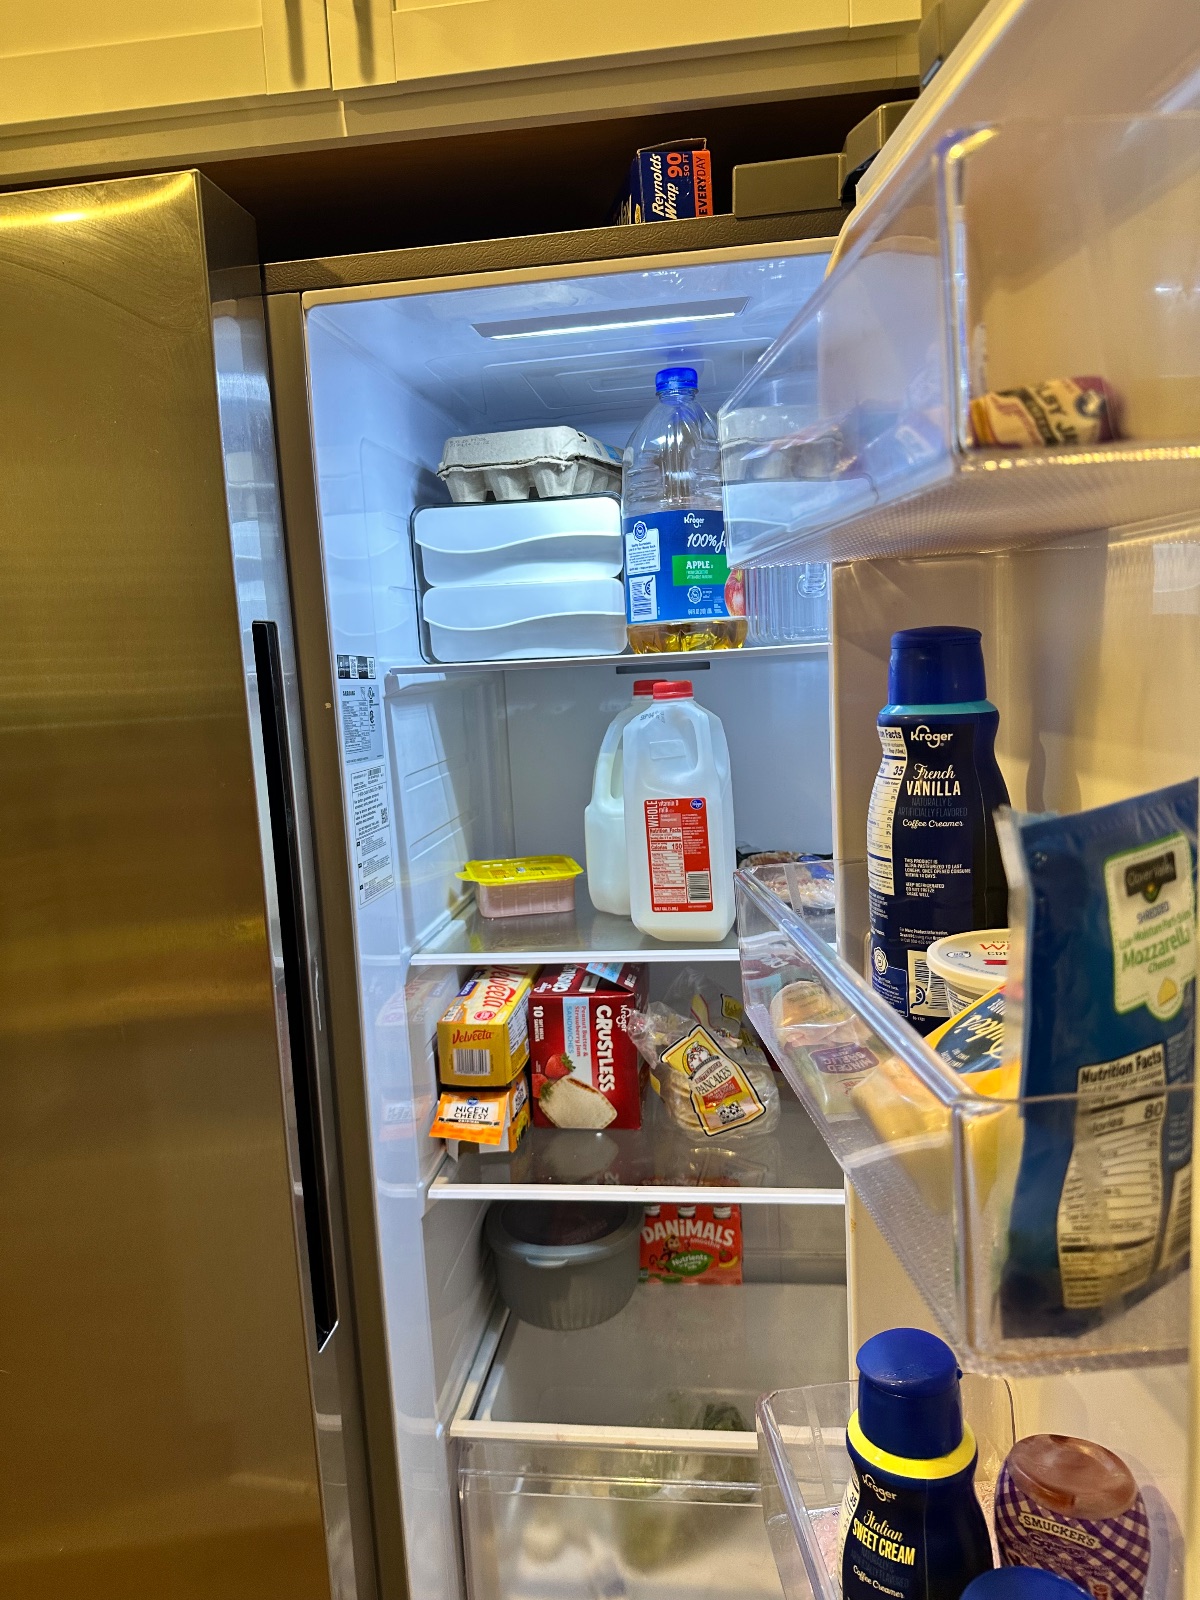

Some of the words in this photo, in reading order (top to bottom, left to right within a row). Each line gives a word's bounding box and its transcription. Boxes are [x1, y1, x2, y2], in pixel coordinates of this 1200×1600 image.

[666, 152, 682, 178] 90
[649, 153, 665, 217] Reynolds
[695, 156, 708, 216] EVERYDAY
[664, 182, 680, 220] Wrap
[683, 512, 705, 529] Kroger
[687, 532, 717, 548] 100%
[686, 560, 710, 570] APPLE
[885, 727, 903, 739] Facts
[910, 724, 954, 749] Kroger
[892, 765, 904, 776] 35
[912, 762, 956, 780] French
[906, 780, 961, 797] VANILLA
[911, 797, 946, 807] NATURALLY
[646, 800, 660, 828] WHOLE
[936, 807, 968, 817] FLAVORED
[902, 818, 927, 830] Coffee
[928, 819, 964, 828] Creamer
[533, 1005, 544, 1018] 10
[615, 1004, 632, 1033] Kroger
[566, 1005, 575, 1054] SANDWICHES
[574, 1005, 582, 1044] Strawberry
[452, 1028, 493, 1045] Velveeta
[595, 1004, 616, 1093] CRUSTLESS
[823, 1051, 867, 1065] GARLIC
[826, 1058, 874, 1072] MINCED
[1080, 1061, 1134, 1084] Nutrition
[1135, 1049, 1162, 1071] Facts
[694, 1065, 732, 1096] PANCAKES
[453, 1112, 489, 1120] CHEESY
[455, 1105, 489, 1114] NICE'N
[1144, 1101, 1164, 1120] 80
[671, 1253, 708, 1266] Nutrients
[861, 1473, 898, 1502] Kroger
[863, 1509, 904, 1543] Italian
[1023, 1515, 1097, 1548] SMUCKER'S
[852, 1517, 879, 1552] SWEET
[878, 1537, 916, 1566] CREAM
[852, 1564, 873, 1585] Coffee
[872, 1579, 905, 1599] Creamer
